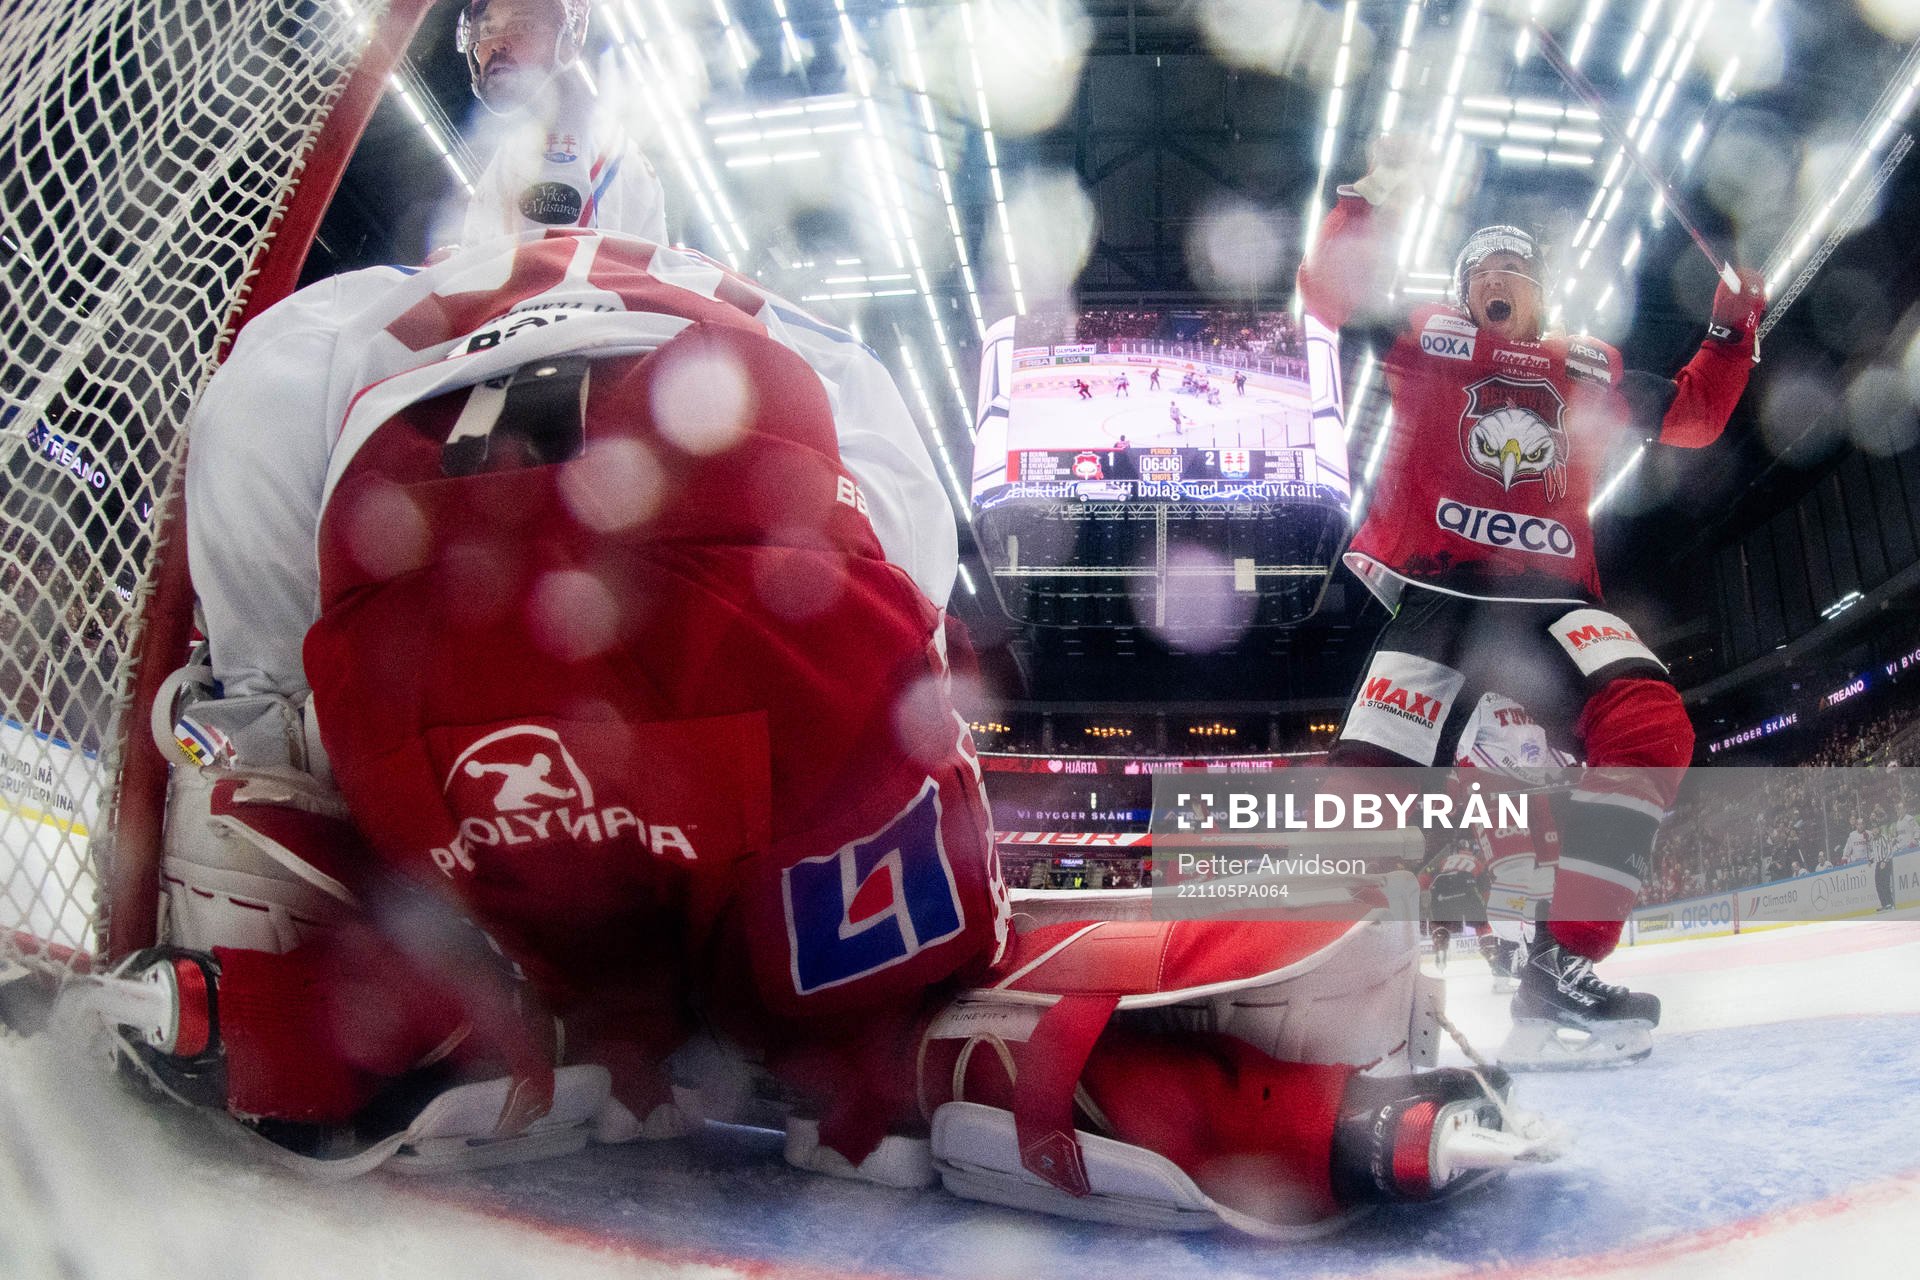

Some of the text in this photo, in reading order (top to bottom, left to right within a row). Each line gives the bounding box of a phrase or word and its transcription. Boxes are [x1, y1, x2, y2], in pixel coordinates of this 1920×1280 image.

[1422, 335, 1471, 357] DOXA
[1107, 451, 1115, 467] 1
[1143, 457, 1180, 472] 06:06
[1205, 451, 1215, 466] 2
[1138, 481, 1180, 500] bolag
[1187, 481, 1218, 498] med
[1438, 502, 1573, 554] areco
[1886, 662, 1898, 676] VI
[1362, 677, 1443, 723] MAXI
[1828, 679, 1864, 706] TREANO
[1368, 700, 1433, 729] STORMARKNAD
[1709, 713, 1798, 752] VI BYGGER SKÅNE
[1065, 760, 1098, 774] HJÄRTA
[1142, 762, 1184, 775] KVALITET
[1230, 761, 1274, 774] STOLTHET
[1017, 809, 1133, 820] VI BYGGER SKÅNE
[1830, 870, 1867, 894] Malmö
[1762, 890, 1798, 908] Climat80
[1681, 901, 1731, 930] areco
